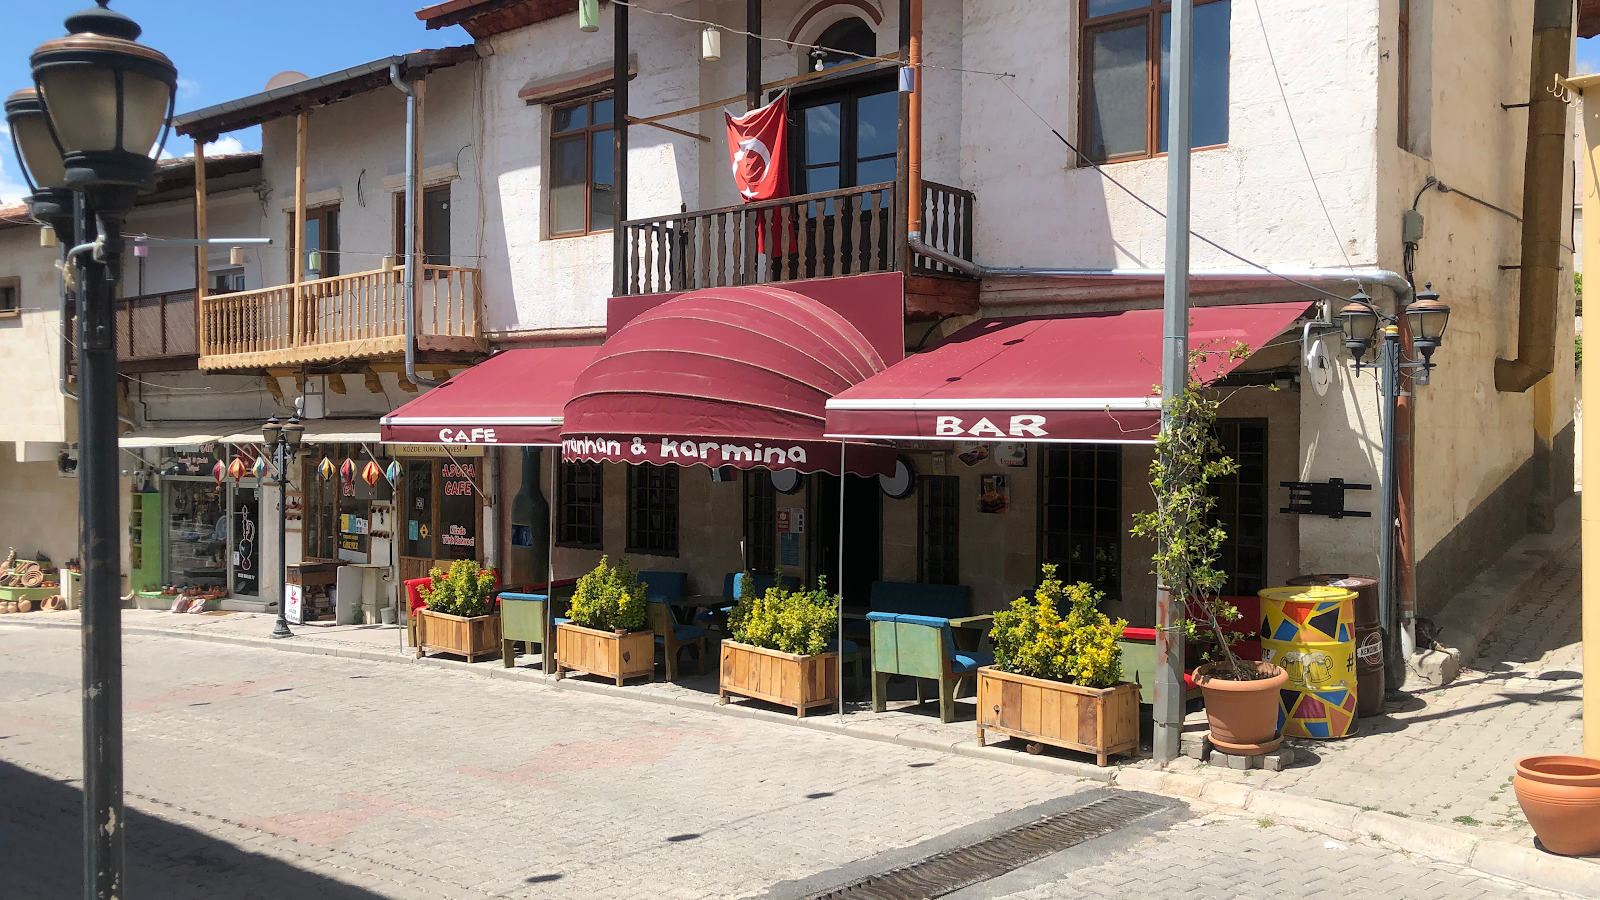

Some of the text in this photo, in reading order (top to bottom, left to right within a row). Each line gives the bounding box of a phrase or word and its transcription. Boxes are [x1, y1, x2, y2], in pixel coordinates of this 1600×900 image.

[936, 415, 1049, 437] BAR
[439, 428, 498, 443] CAFE
[631, 436, 646, 455] &
[660, 437, 807, 464] karmina
[445, 481, 471, 496] CAFE
